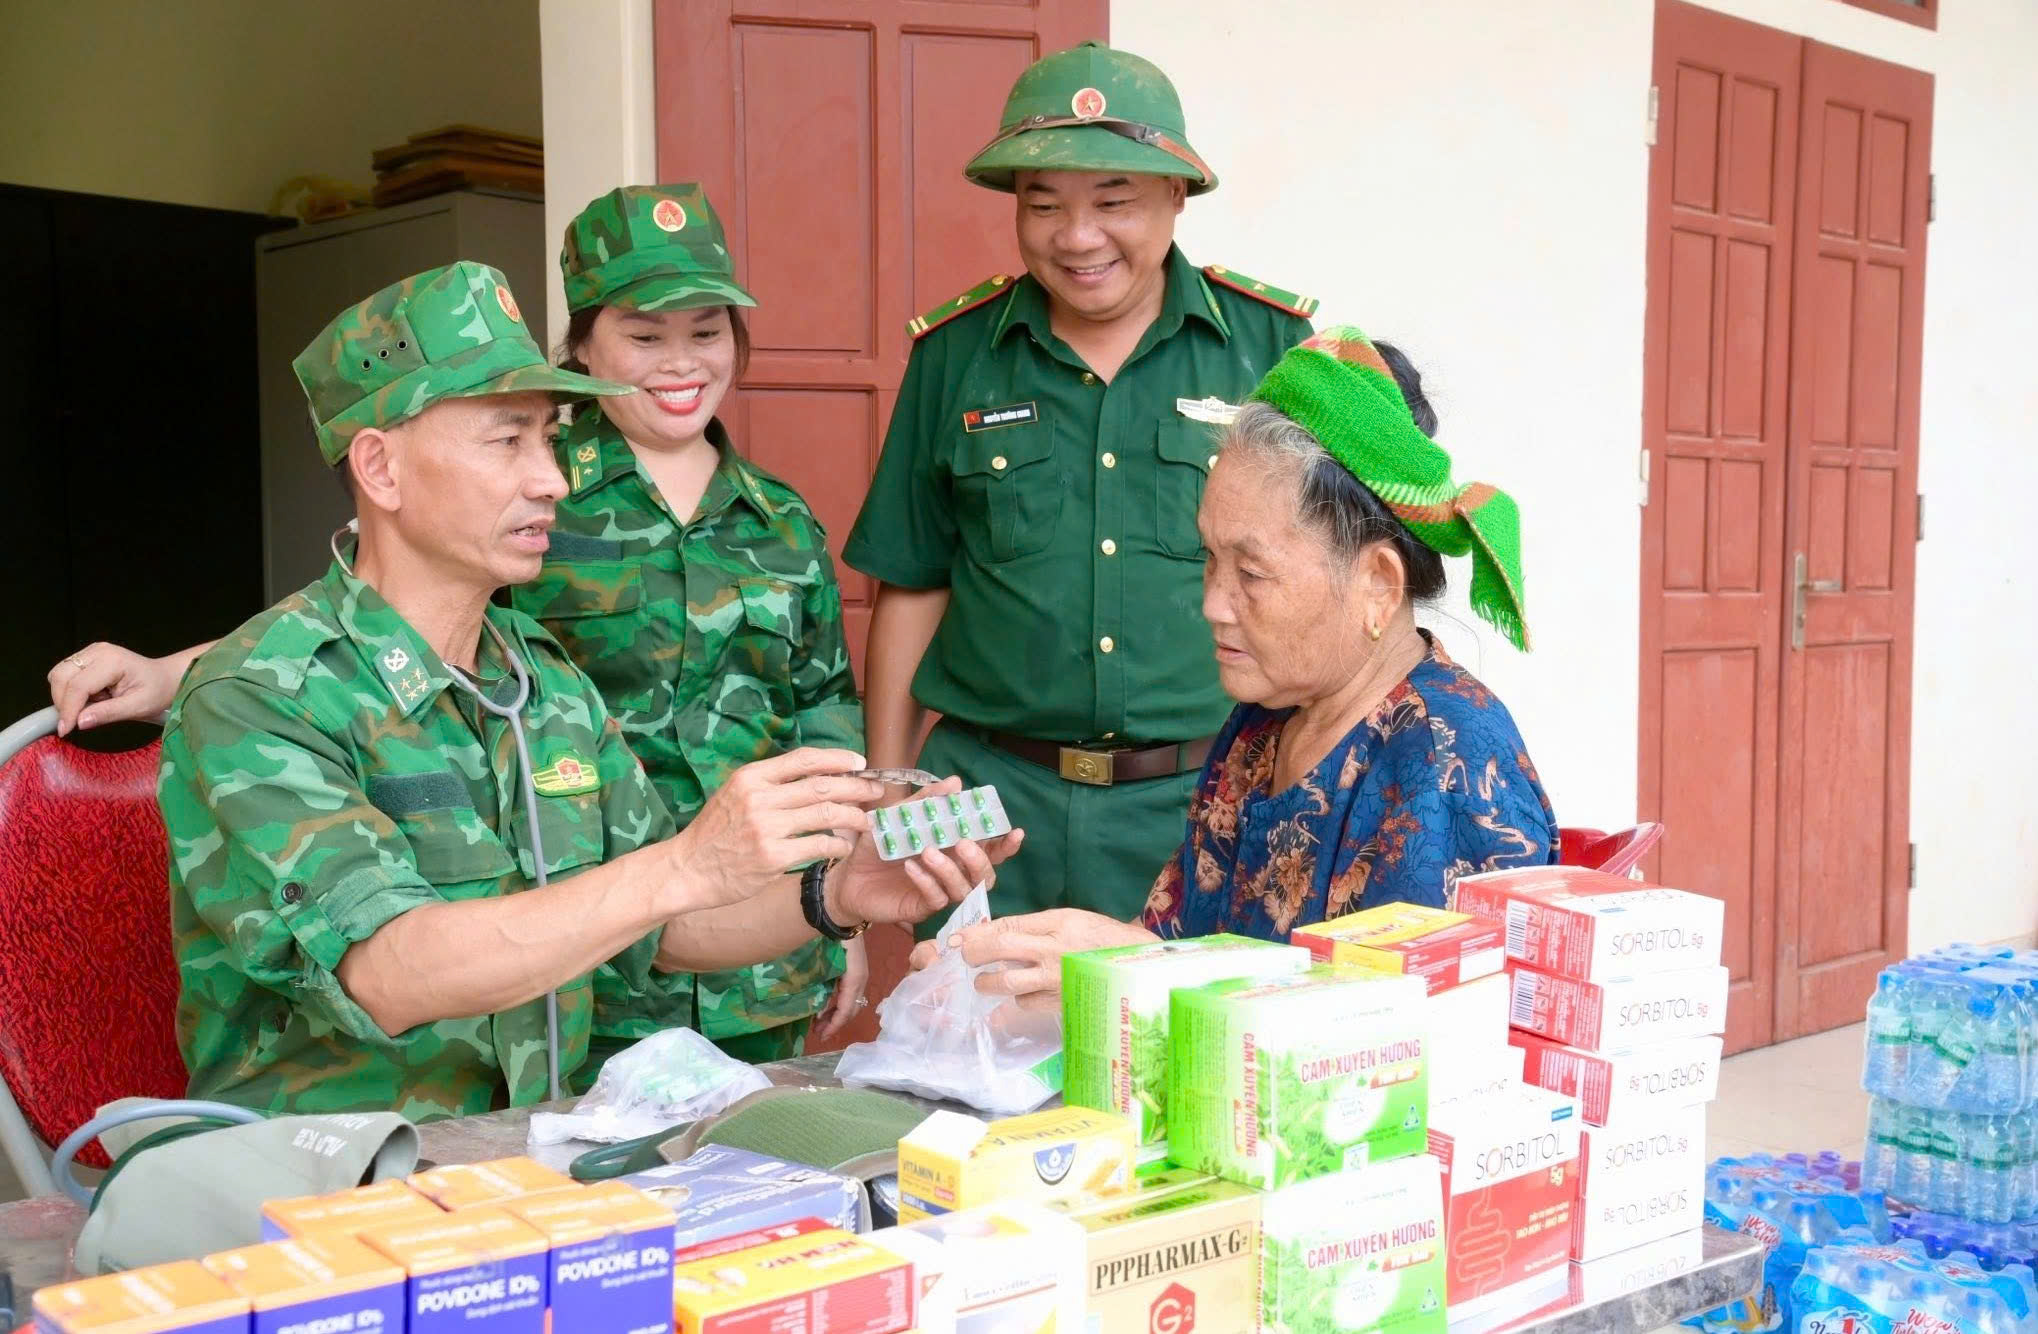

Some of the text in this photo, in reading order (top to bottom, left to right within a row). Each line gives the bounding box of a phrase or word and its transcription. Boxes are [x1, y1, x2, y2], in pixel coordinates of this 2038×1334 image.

[1611, 928, 1688, 956] SORBITOL
[1618, 998, 1694, 1027] SORBITOL
[1642, 1061, 1707, 1094] SORBITOL
[1475, 1133, 1564, 1181] SORBITOL
[1605, 1134, 1673, 1169] SORBITOL
[556, 1250, 639, 1284] POVIDONE
[640, 1246, 670, 1267] 10%
[416, 1278, 507, 1316] POVIDONE
[508, 1273, 541, 1296] 10%
